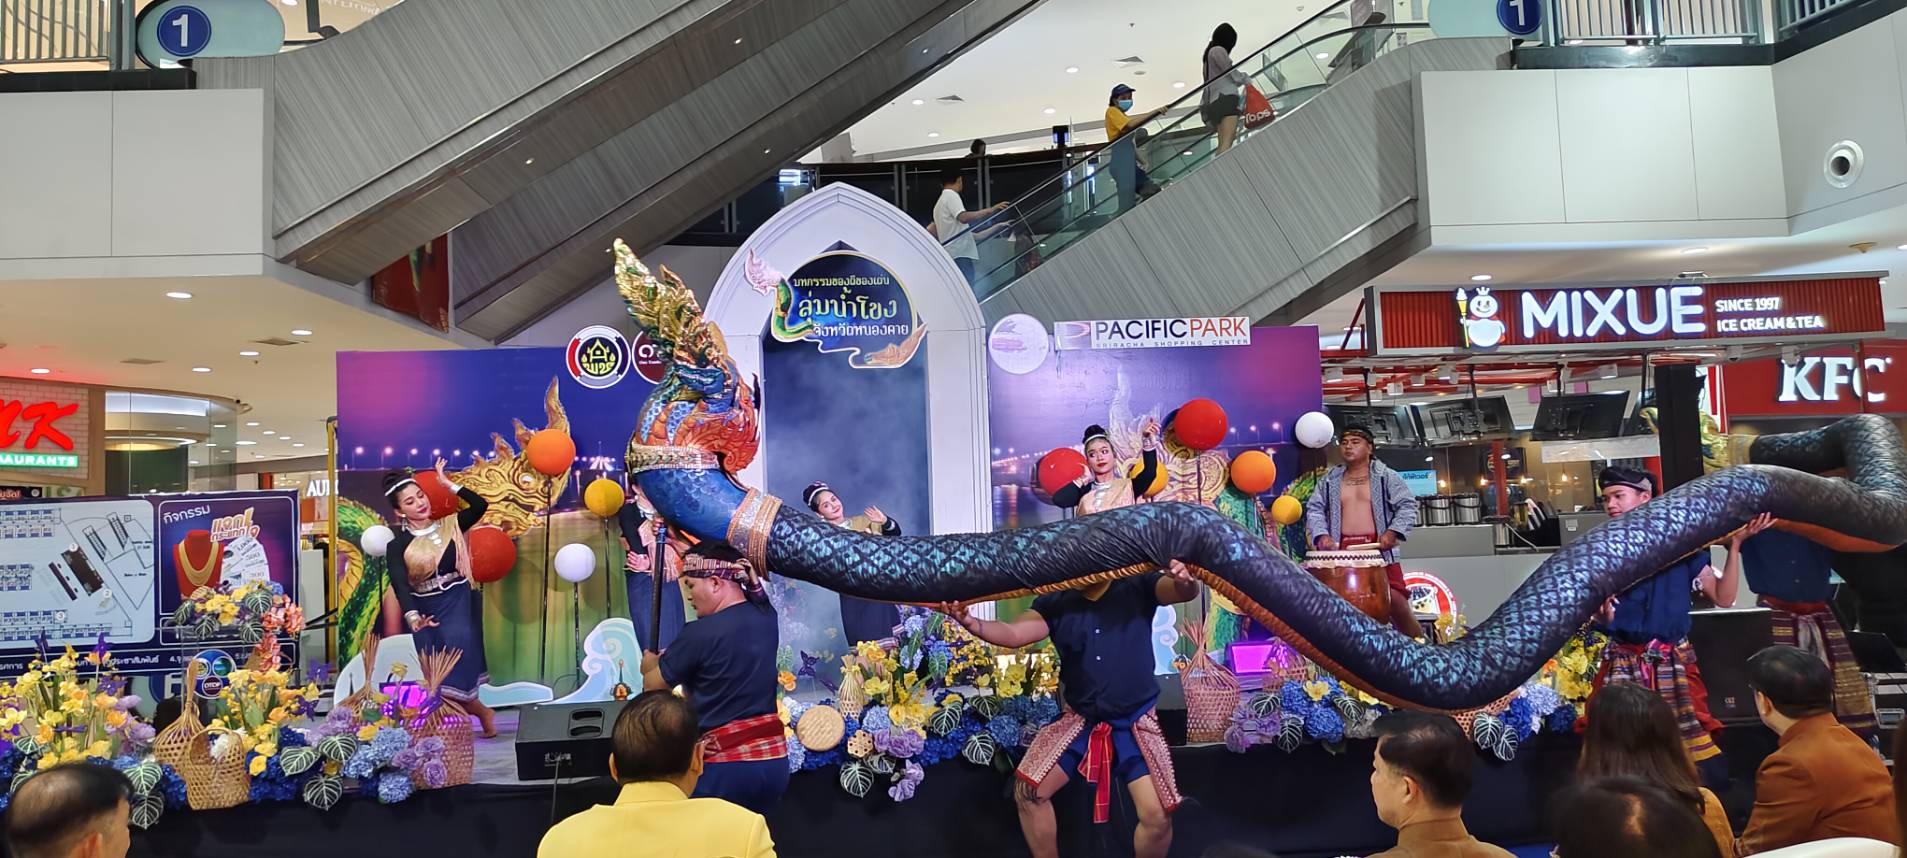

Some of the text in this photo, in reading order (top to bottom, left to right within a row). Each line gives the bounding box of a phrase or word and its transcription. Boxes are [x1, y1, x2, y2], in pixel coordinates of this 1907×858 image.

[1509, 0, 1525, 26] 1
[172, 14, 189, 47] 1
[1521, 286, 1706, 339] MIXUE
[1715, 296, 1781, 313] SINCE 1997
[1716, 318, 1739, 333] ICE
[1211, 338, 1248, 346] CENTER
[1778, 356, 1887, 403] KFC
[163, 505, 211, 524] กิจกรรม
